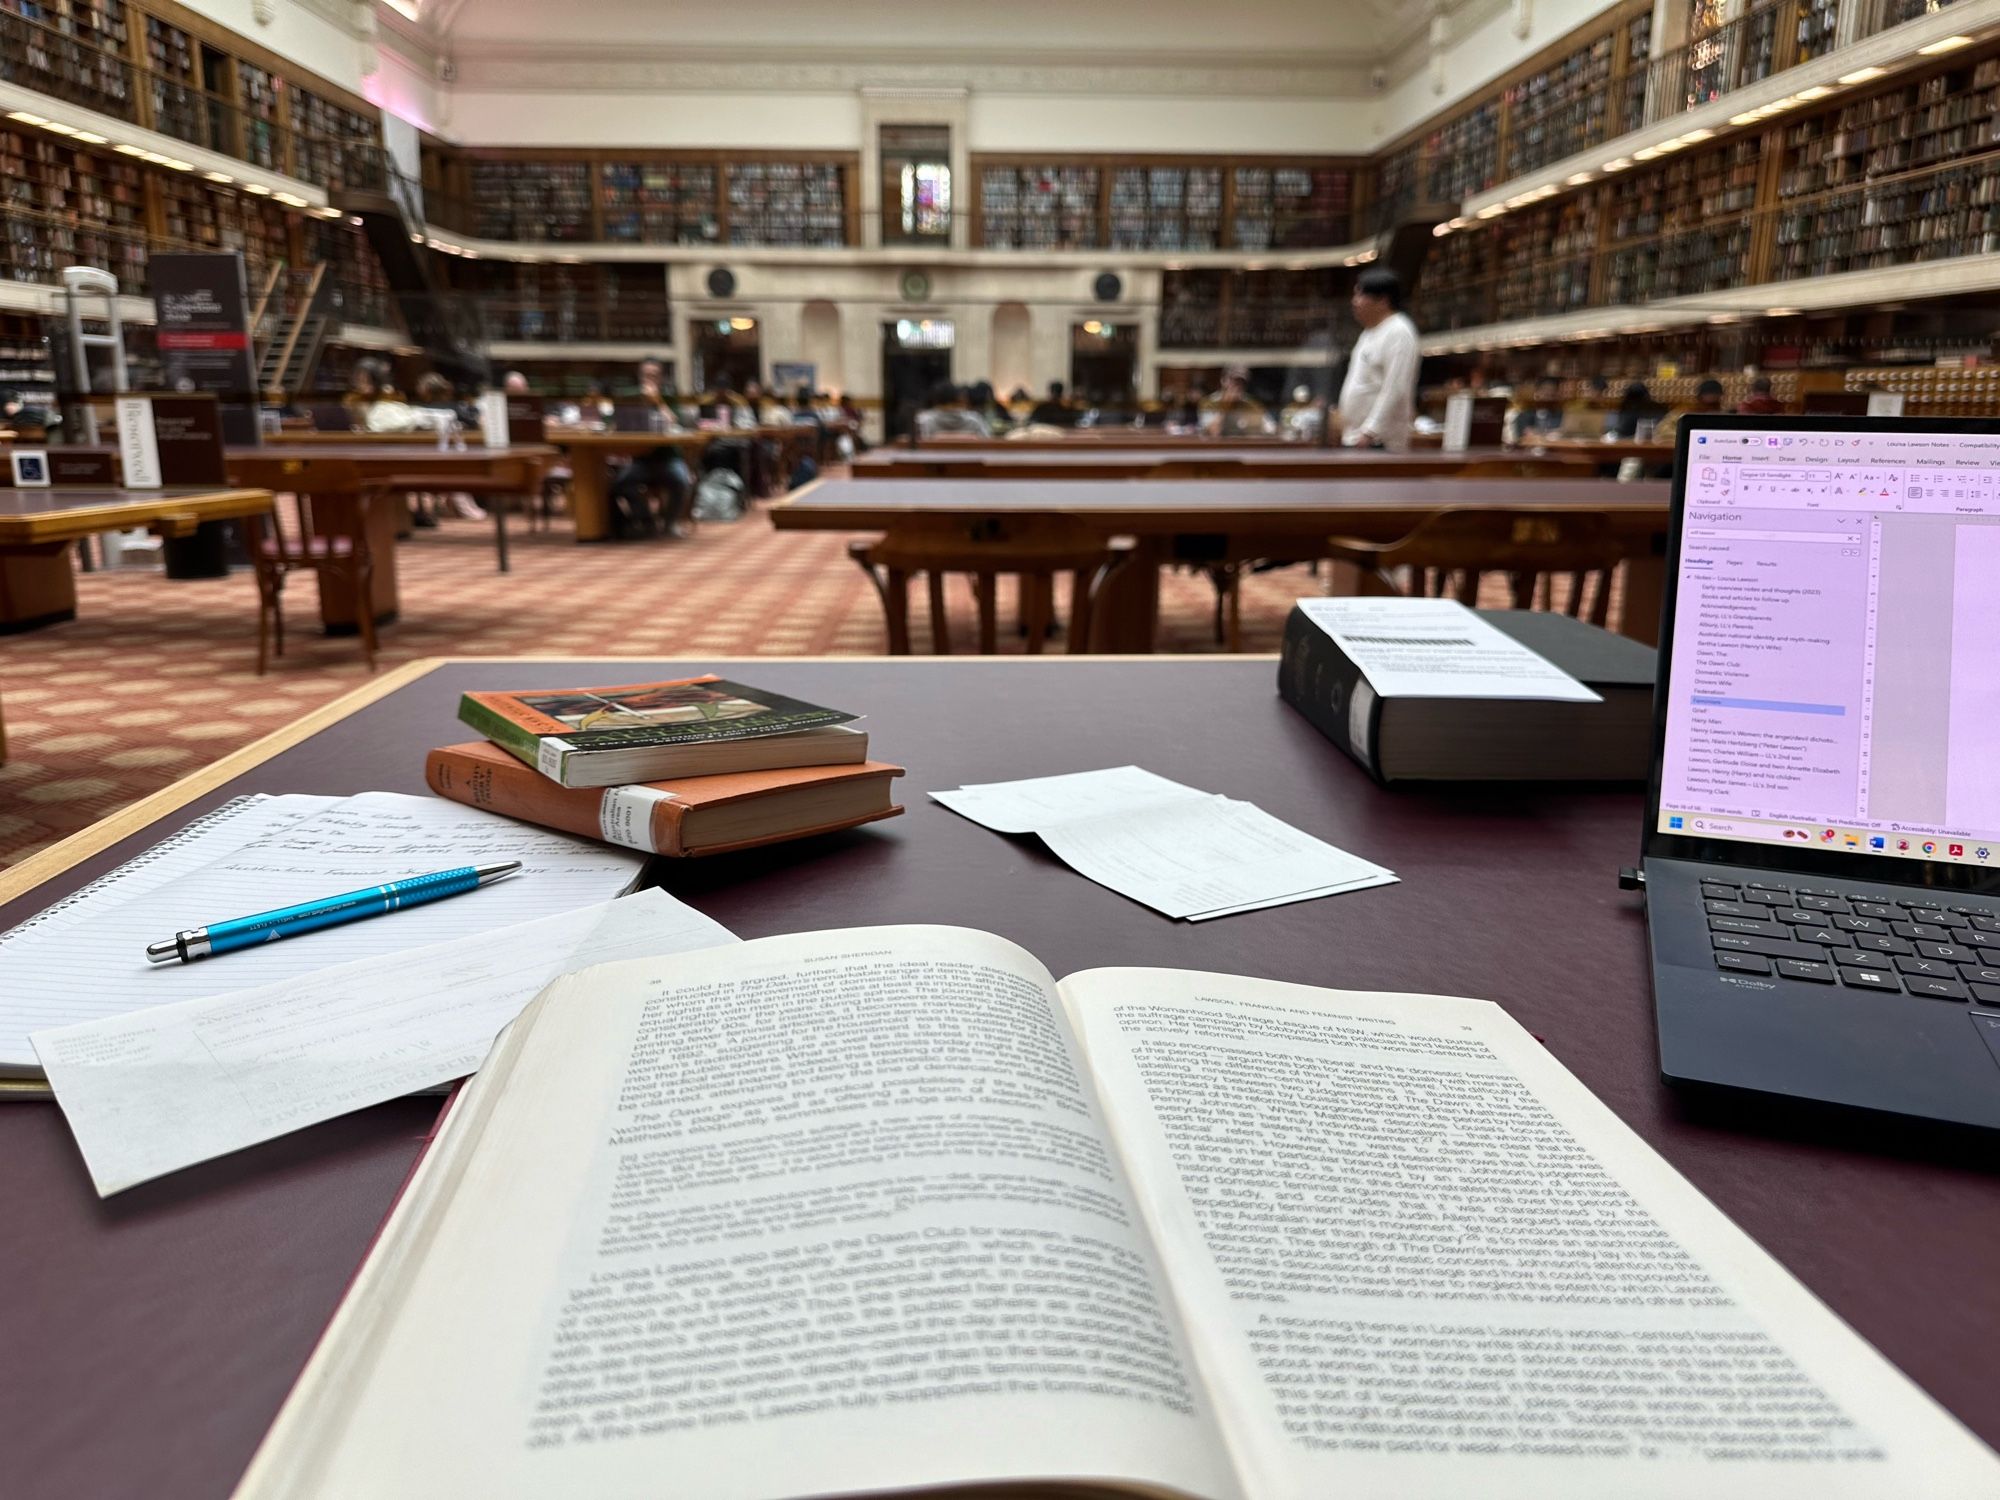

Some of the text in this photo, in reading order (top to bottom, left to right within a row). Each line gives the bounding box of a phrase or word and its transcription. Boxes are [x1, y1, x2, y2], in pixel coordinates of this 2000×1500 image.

[1688, 512, 1742, 522] Navigation
[1710, 822, 1732, 831] Search
[1938, 829, 1971, 837] Unavailable
[1849, 920, 1869, 928] W
[1816, 932, 1832, 940] A
[1878, 939, 1890, 947] S
[804, 950, 892, 963] SUSAN SHERIDAN
[1854, 954, 1868, 962] Z
[1918, 962, 1932, 971] X
[676, 984, 712, 994] could
[935, 960, 974, 970] reader
[1981, 970, 2000, 979] C
[1738, 979, 1776, 989] Dolby
[1929, 983, 1948, 992] Alt
[1356, 1016, 1396, 1026] WRITING
[1149, 1005, 1223, 1019] Womanhood
[1225, 1011, 1274, 1025] Suffrage
[1276, 1019, 1321, 1032] League
[1370, 1030, 1406, 1039] which
[1408, 1035, 1442, 1043] would
[1444, 1038, 1484, 1047] pursue
[1138, 1012, 1186, 1022] suffrage
[1188, 1015, 1247, 1028] campaign
[1250, 1023, 1263, 1031] by
[1265, 1024, 1317, 1037] lobbying
[1320, 1032, 1348, 1040] male
[1350, 1036, 1408, 1047] politicians
[1435, 1044, 1477, 1052] leaders
[1146, 1026, 1189, 1036] actively
[1275, 1316, 1353, 1332] recurring
[1355, 1320, 1409, 1333] theme
[1430, 1323, 1485, 1336] Louisa
